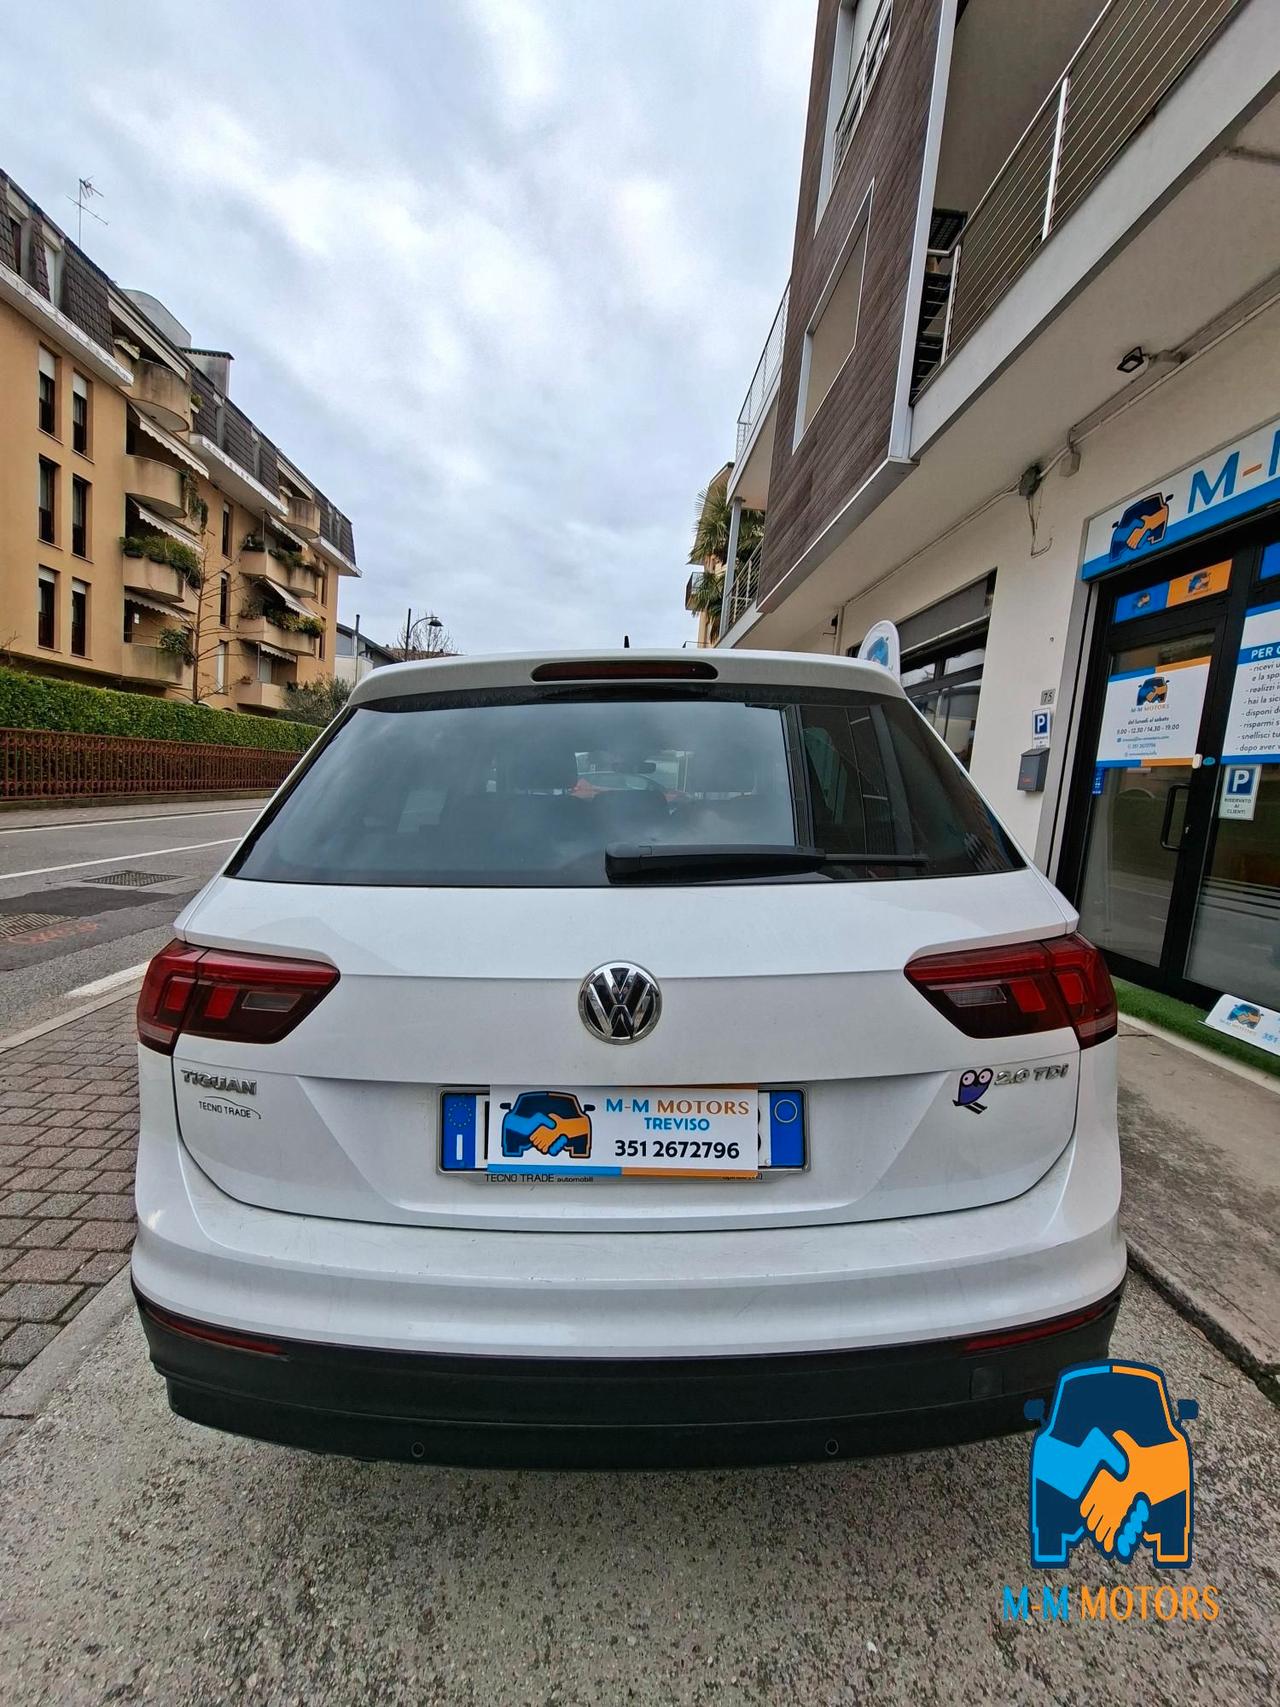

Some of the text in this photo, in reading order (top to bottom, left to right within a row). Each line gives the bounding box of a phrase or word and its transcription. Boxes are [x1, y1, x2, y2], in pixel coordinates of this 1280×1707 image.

[1187, 429, 1280, 514] M-
[1251, 646, 1274, 659] PER
[1253, 662, 1274, 671] ricevi
[1258, 673, 1265, 681] la
[1249, 683, 1275, 693] realizzi
[1247, 697, 1259, 705] hai
[1245, 707, 1272, 718] disponi
[1036, 715, 1046, 733] P
[1244, 718, 1274, 730] risparmi
[1241, 730, 1271, 740] snellisci
[1240, 744, 1258, 753] dopo
[1232, 769, 1250, 792] P
[994, 1063, 1069, 1086] 2.0 TDI
[181, 1067, 258, 1095] TIGUAN
[199, 1100, 252, 1119] TECNO TRADE
[606, 1098, 750, 1116] M-M MOTORS
[644, 1117, 710, 1131] TREVISO
[485, 1173, 594, 1183] TECNO TRADE automobili
